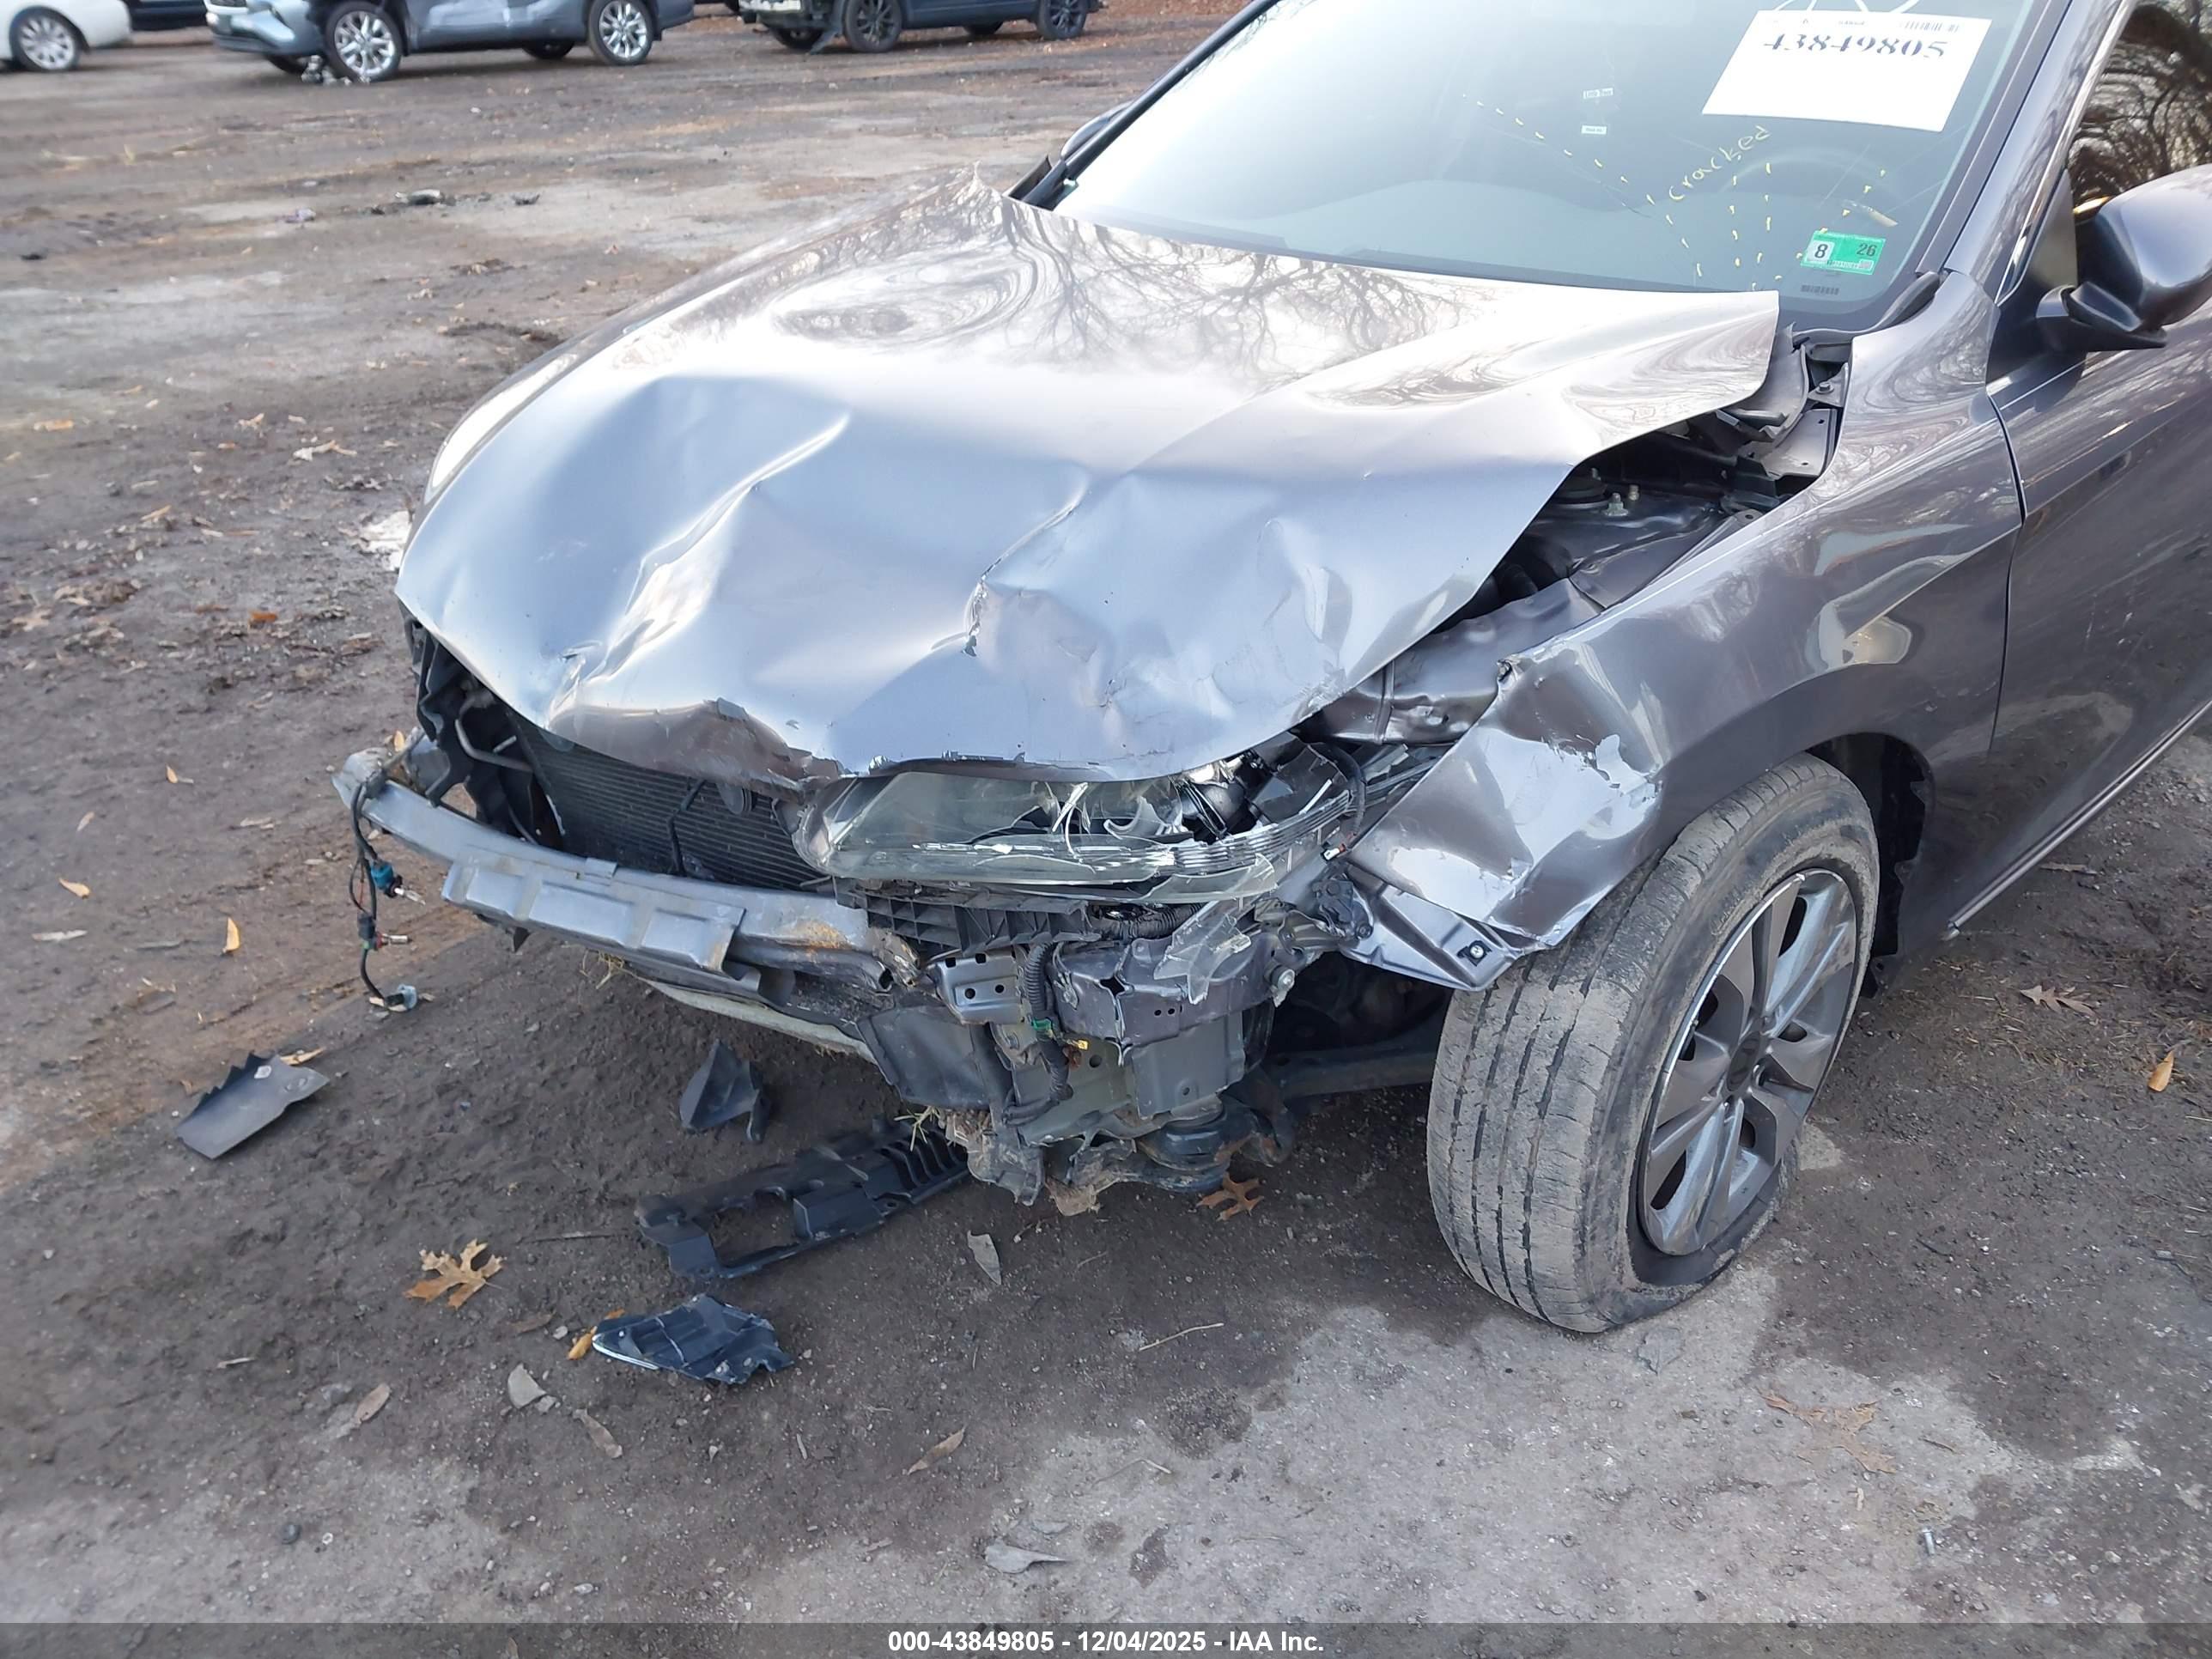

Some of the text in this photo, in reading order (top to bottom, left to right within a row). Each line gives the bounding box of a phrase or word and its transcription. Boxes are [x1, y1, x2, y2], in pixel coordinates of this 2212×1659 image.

[1763, 33, 1948, 58] 43849805
[1814, 242, 1878, 258] 8 26
